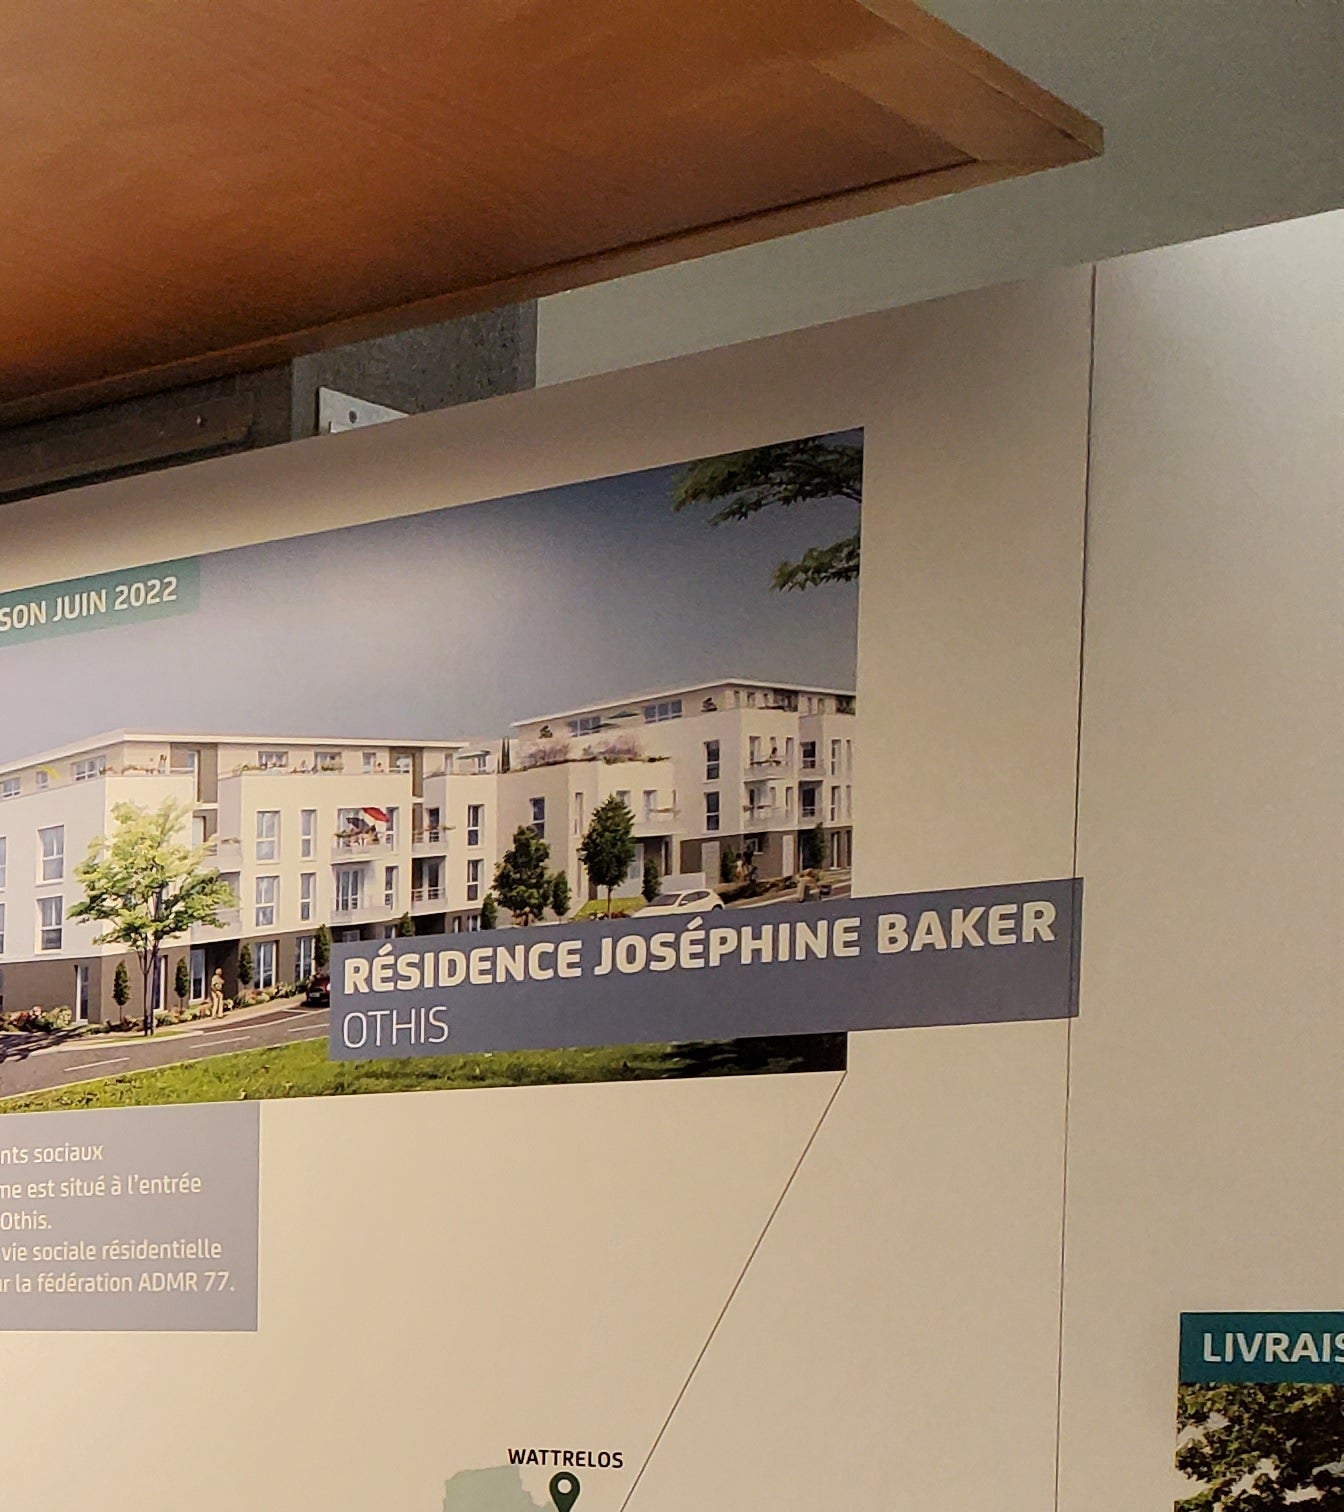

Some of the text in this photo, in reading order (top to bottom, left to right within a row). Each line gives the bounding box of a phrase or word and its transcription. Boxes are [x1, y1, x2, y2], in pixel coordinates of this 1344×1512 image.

[52, 589, 106, 623] JUIN
[113, 576, 177, 611] 2022
[342, 900, 1057, 995] RÉSIDENCE JOSÉPHINE BAKER
[341, 1006, 449, 1050] OTHIS
[33, 1142, 104, 1164] sociaux
[27, 1180, 55, 1198] est
[59, 1176, 105, 1197] situé
[110, 1176, 121, 1195] à
[1, 1242, 28, 1262] vie
[32, 1241, 97, 1262] sociale
[101, 1237, 222, 1260] résidentielle
[15, 1272, 32, 1293] la
[36, 1271, 133, 1293] fédération
[137, 1271, 199, 1293] ADMR
[203, 1270, 236, 1292] 77.
[507, 1448, 624, 1469] WATTRELOS
